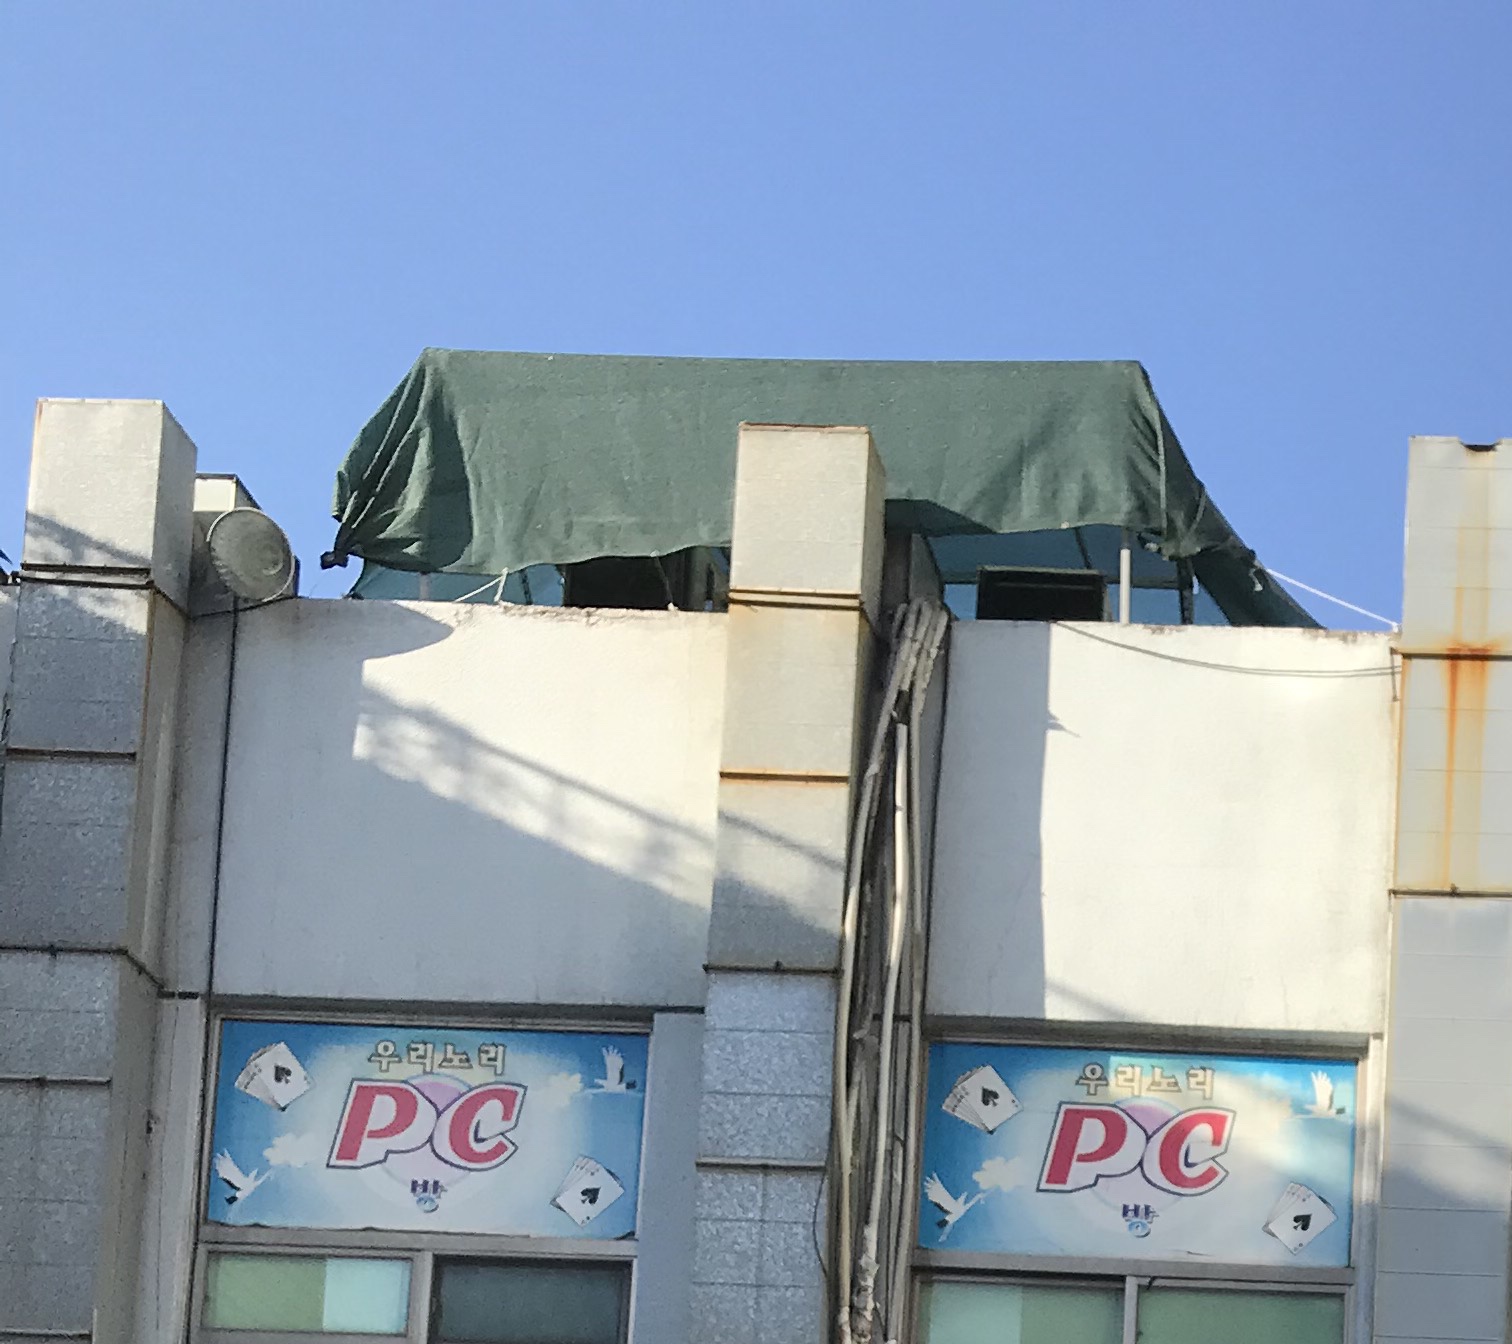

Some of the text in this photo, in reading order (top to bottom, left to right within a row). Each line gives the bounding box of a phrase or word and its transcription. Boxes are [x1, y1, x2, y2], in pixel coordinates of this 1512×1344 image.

[368, 1040, 506, 1076] 우리노리
[1075, 1062, 1215, 1100] 우리노리
[327, 1078, 528, 1171] PC
[1036, 1101, 1236, 1196] PC
